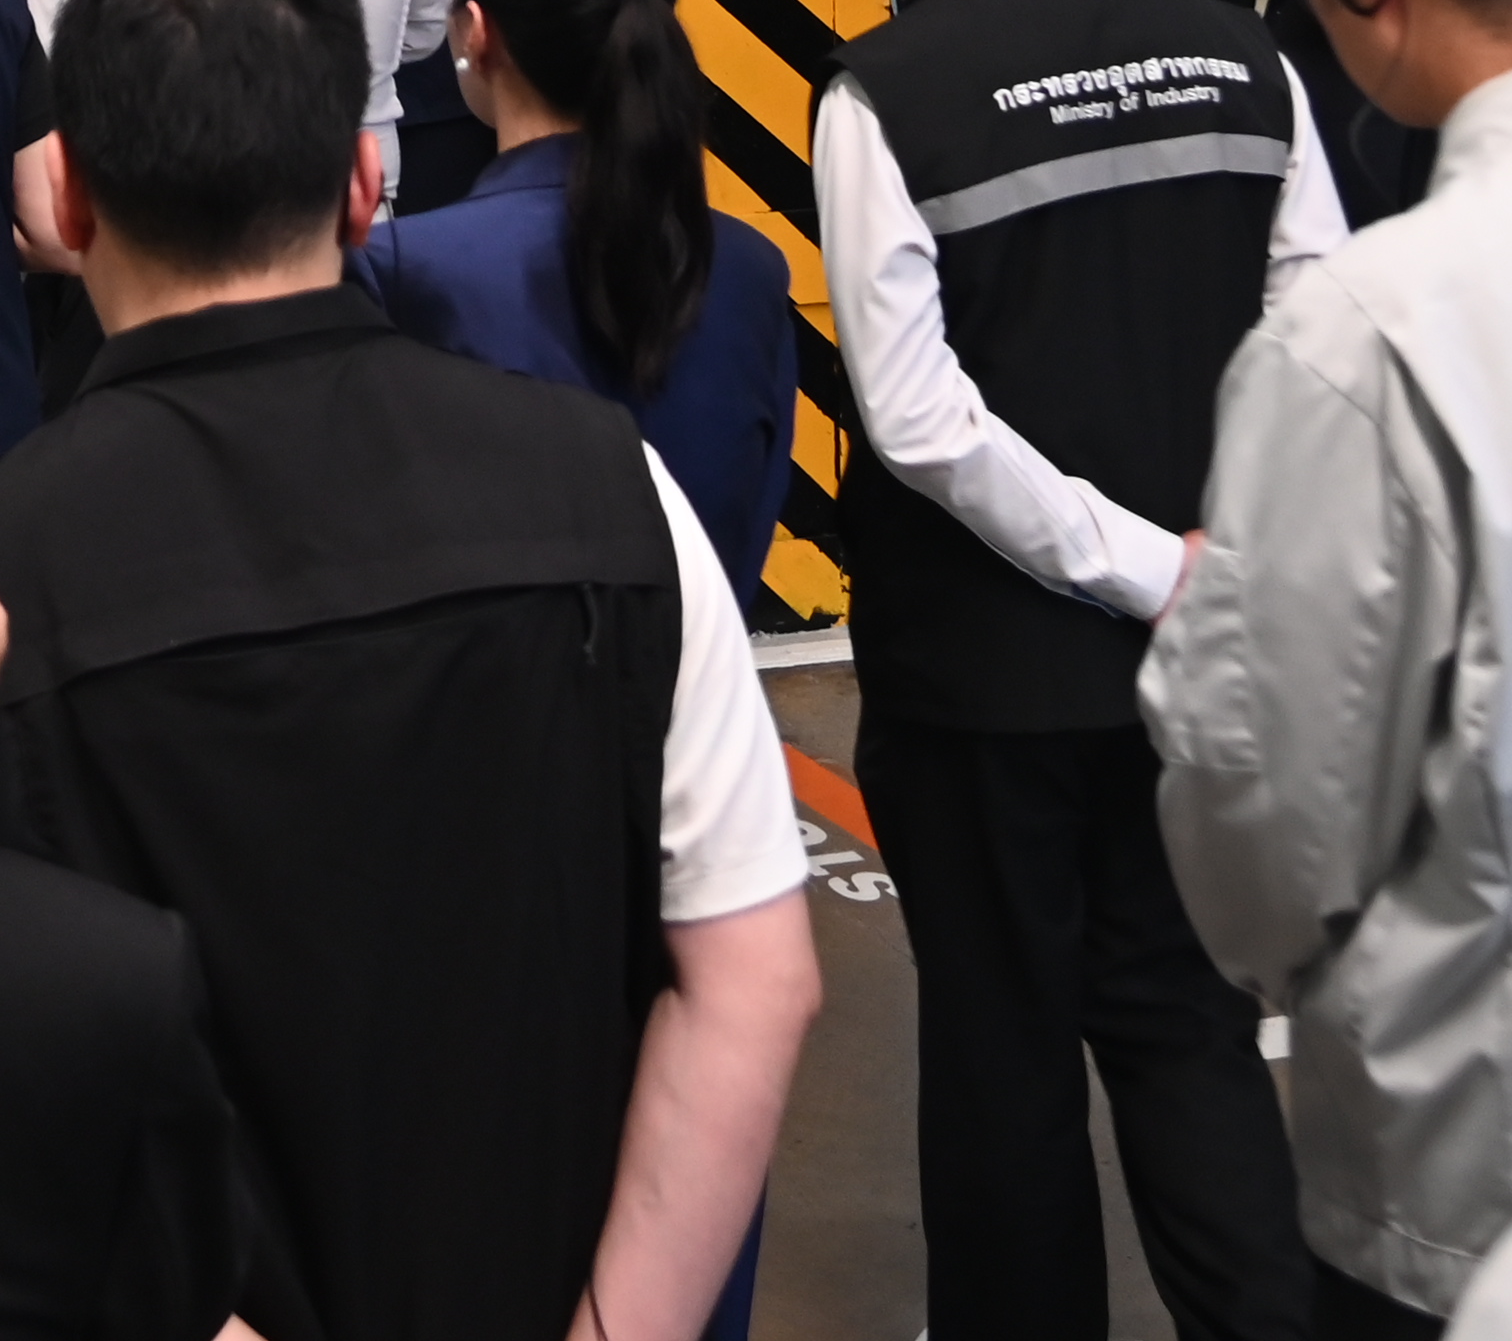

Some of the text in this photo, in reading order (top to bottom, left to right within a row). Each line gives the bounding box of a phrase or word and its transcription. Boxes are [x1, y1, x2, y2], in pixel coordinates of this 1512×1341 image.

[993, 56, 1251, 111] กระทรวงอุตสาหกรรม
[1049, 84, 1221, 124] Ministry of Industry
